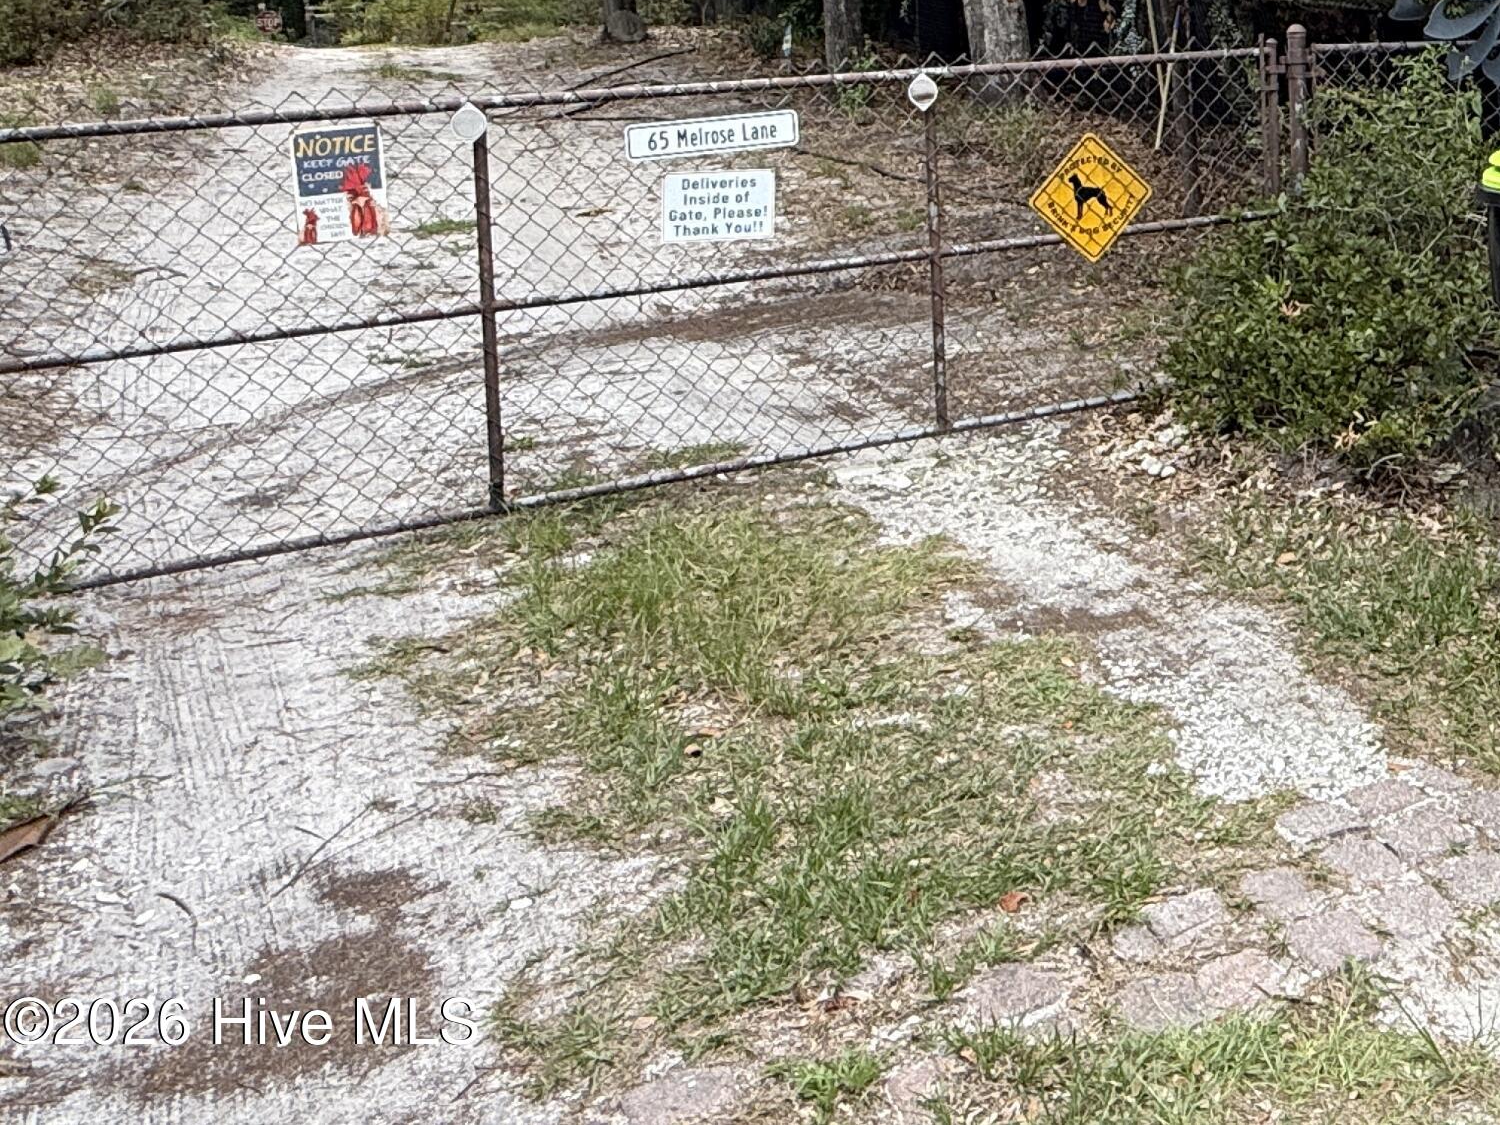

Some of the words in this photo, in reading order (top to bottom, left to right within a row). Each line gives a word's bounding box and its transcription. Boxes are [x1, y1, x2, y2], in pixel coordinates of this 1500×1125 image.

[256, 17, 280, 28] STOP
[647, 130, 669, 151] 65
[677, 127, 735, 149] Melrose
[742, 122, 777, 142] Lane
[296, 134, 377, 158] NOTICE
[303, 158, 333, 169] KEEP
[336, 155, 370, 168] GATE
[1059, 155, 1110, 182] PROTECTED
[1111, 162, 1122, 173] BY
[302, 170, 343, 183] CLOSED
[681, 177, 757, 191] Deliveries
[683, 193, 730, 206] Inside
[735, 191, 750, 204] of
[669, 209, 707, 222] Gate,
[713, 205, 768, 220] Please!
[1079, 226, 1100, 235] DOG
[1102, 194, 1136, 232] SECURITY
[674, 223, 719, 237] Thank
[725, 220, 764, 234] You!!
